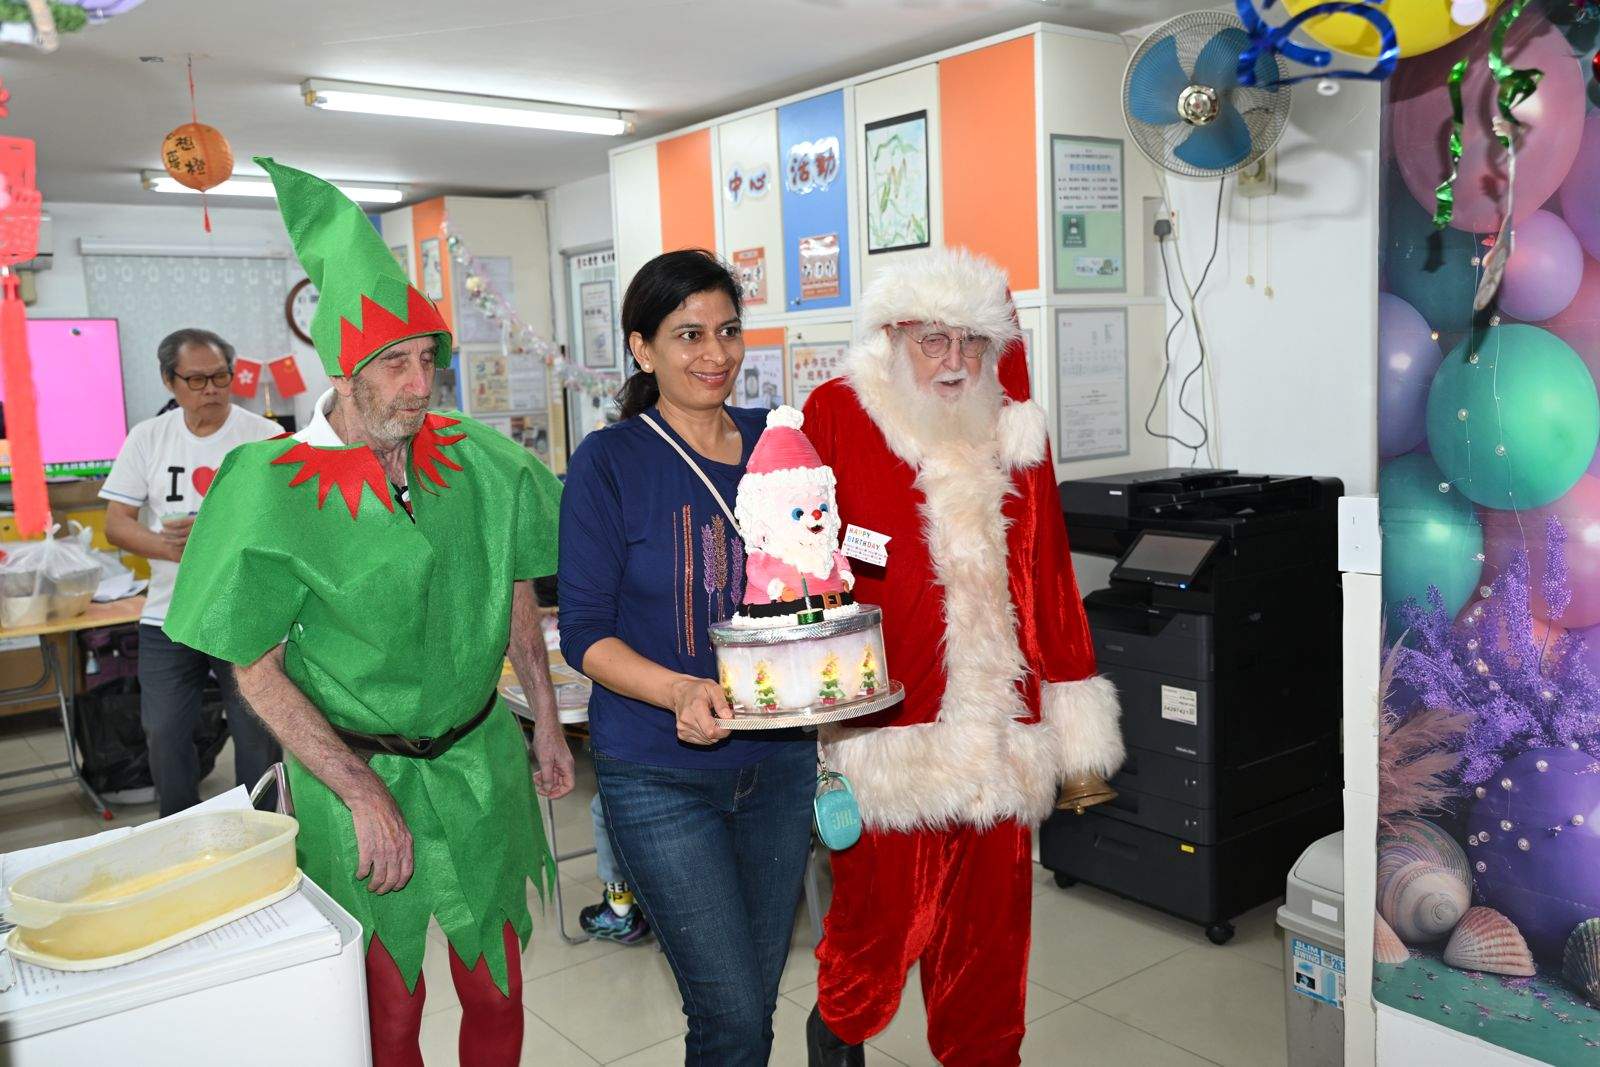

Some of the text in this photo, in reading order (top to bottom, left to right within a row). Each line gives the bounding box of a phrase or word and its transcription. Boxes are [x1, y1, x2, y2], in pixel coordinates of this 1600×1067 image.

[729, 146, 836, 202] 中心 活動
[166, 466, 185, 502] I
[849, 527, 870, 538] HAPPY
[847, 535, 881, 550] BIRTHDAY
[1295, 940, 1320, 956] SLIM
